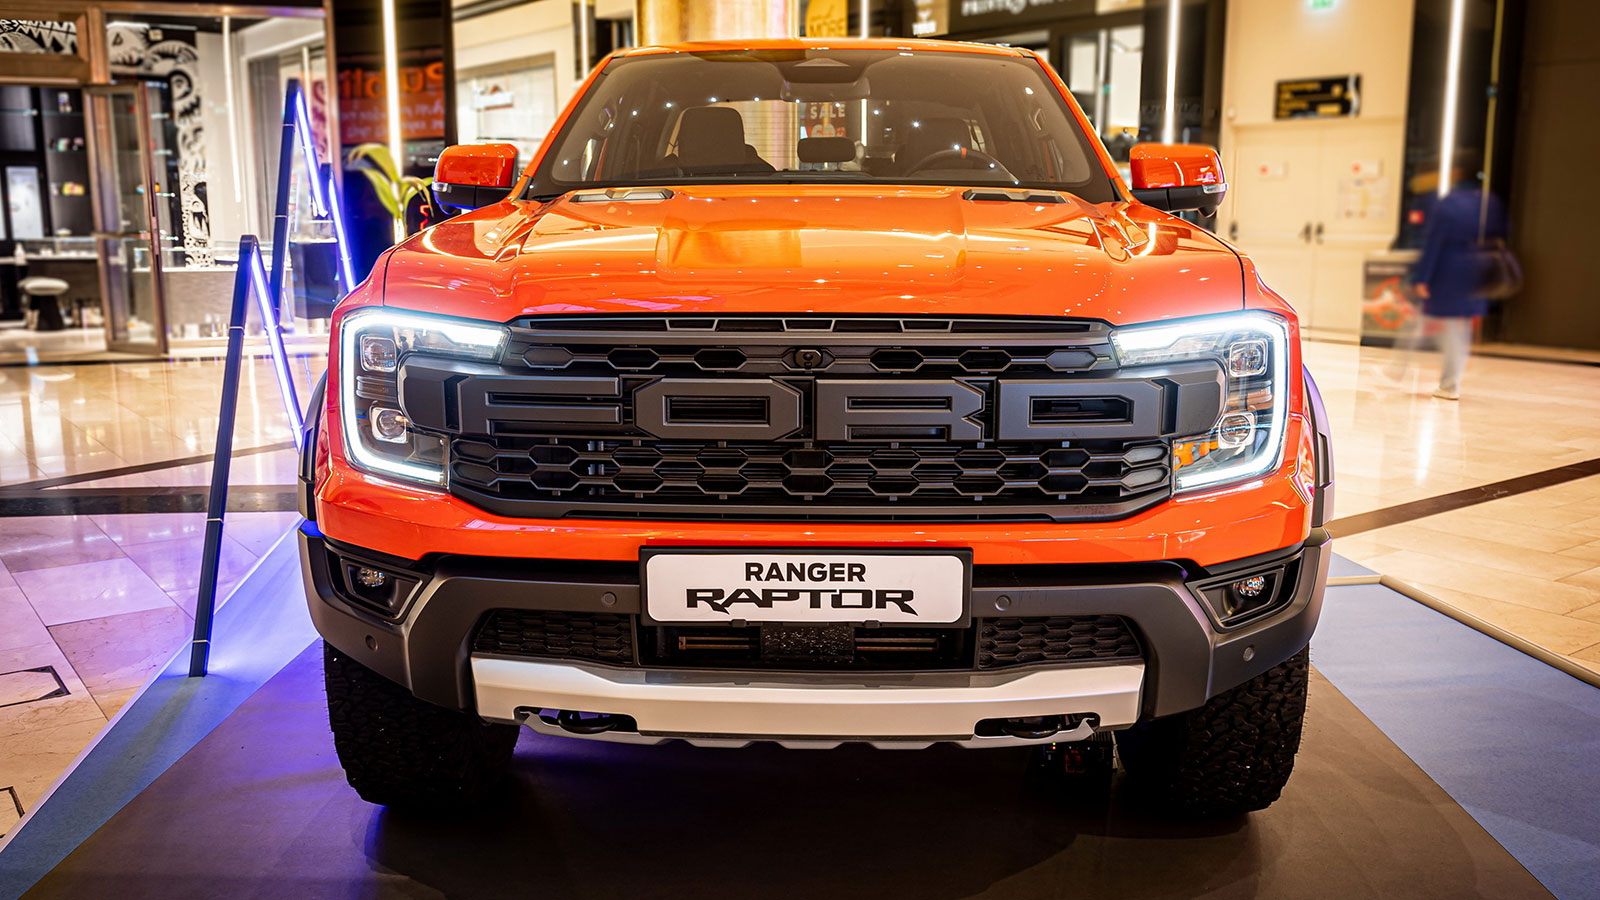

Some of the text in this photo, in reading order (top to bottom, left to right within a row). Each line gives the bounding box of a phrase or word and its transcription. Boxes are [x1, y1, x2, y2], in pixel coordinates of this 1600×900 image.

[810, 103, 846, 119] SALE
[456, 376, 1164, 440] FORD
[745, 562, 867, 582] RANGER
[685, 588, 918, 616] RAPTOR
